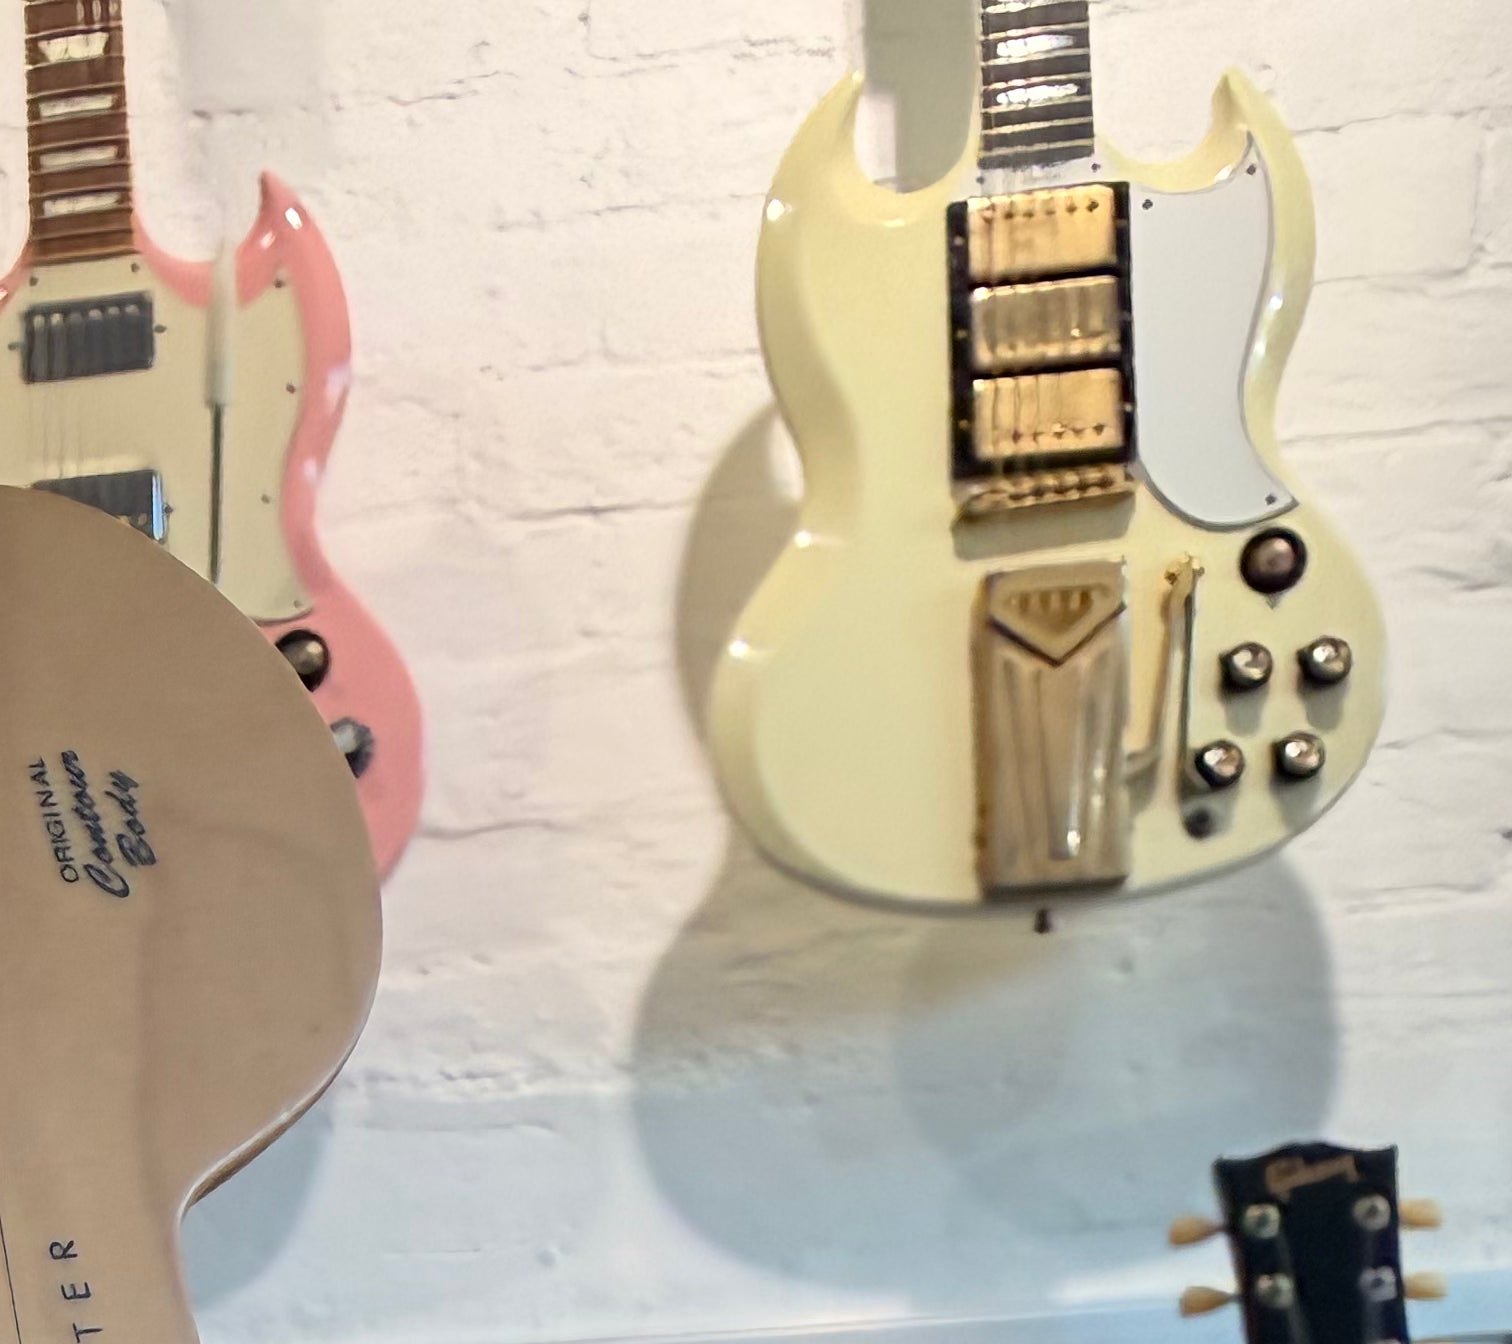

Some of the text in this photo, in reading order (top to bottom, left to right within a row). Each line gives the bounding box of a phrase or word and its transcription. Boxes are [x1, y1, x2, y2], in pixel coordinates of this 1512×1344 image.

[28, 757, 79, 883] ORIGINAL
[61, 750, 130, 898] Contour
[104, 770, 157, 866] Body
